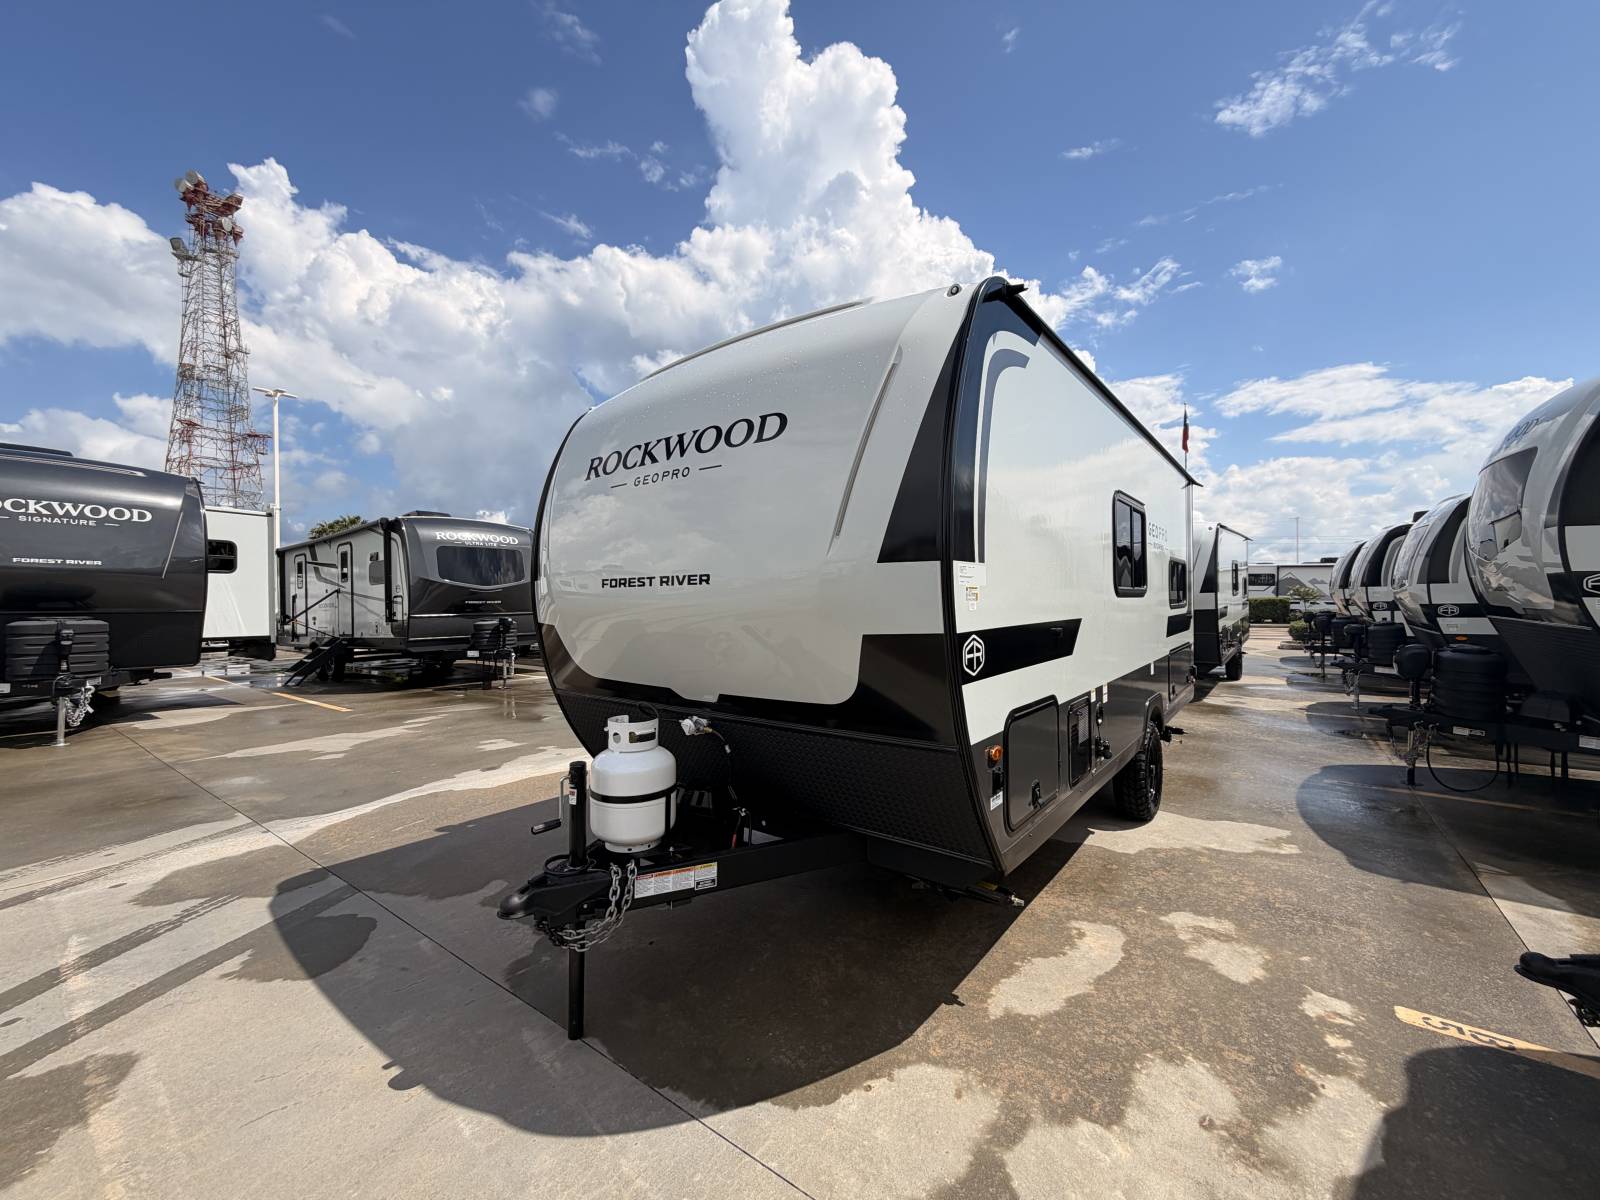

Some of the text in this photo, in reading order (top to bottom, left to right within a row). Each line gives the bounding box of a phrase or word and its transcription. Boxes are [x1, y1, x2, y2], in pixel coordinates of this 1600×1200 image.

[584, 412, 788, 481] ROCKWOOD
[633, 466, 691, 487] GEOPRO
[0, 498, 152, 522] CKWOOD
[18, 515, 97, 527] SIGNATURE
[435, 531, 519, 545] ROCKWOOD
[601, 573, 711, 589] FOREST RIVER
